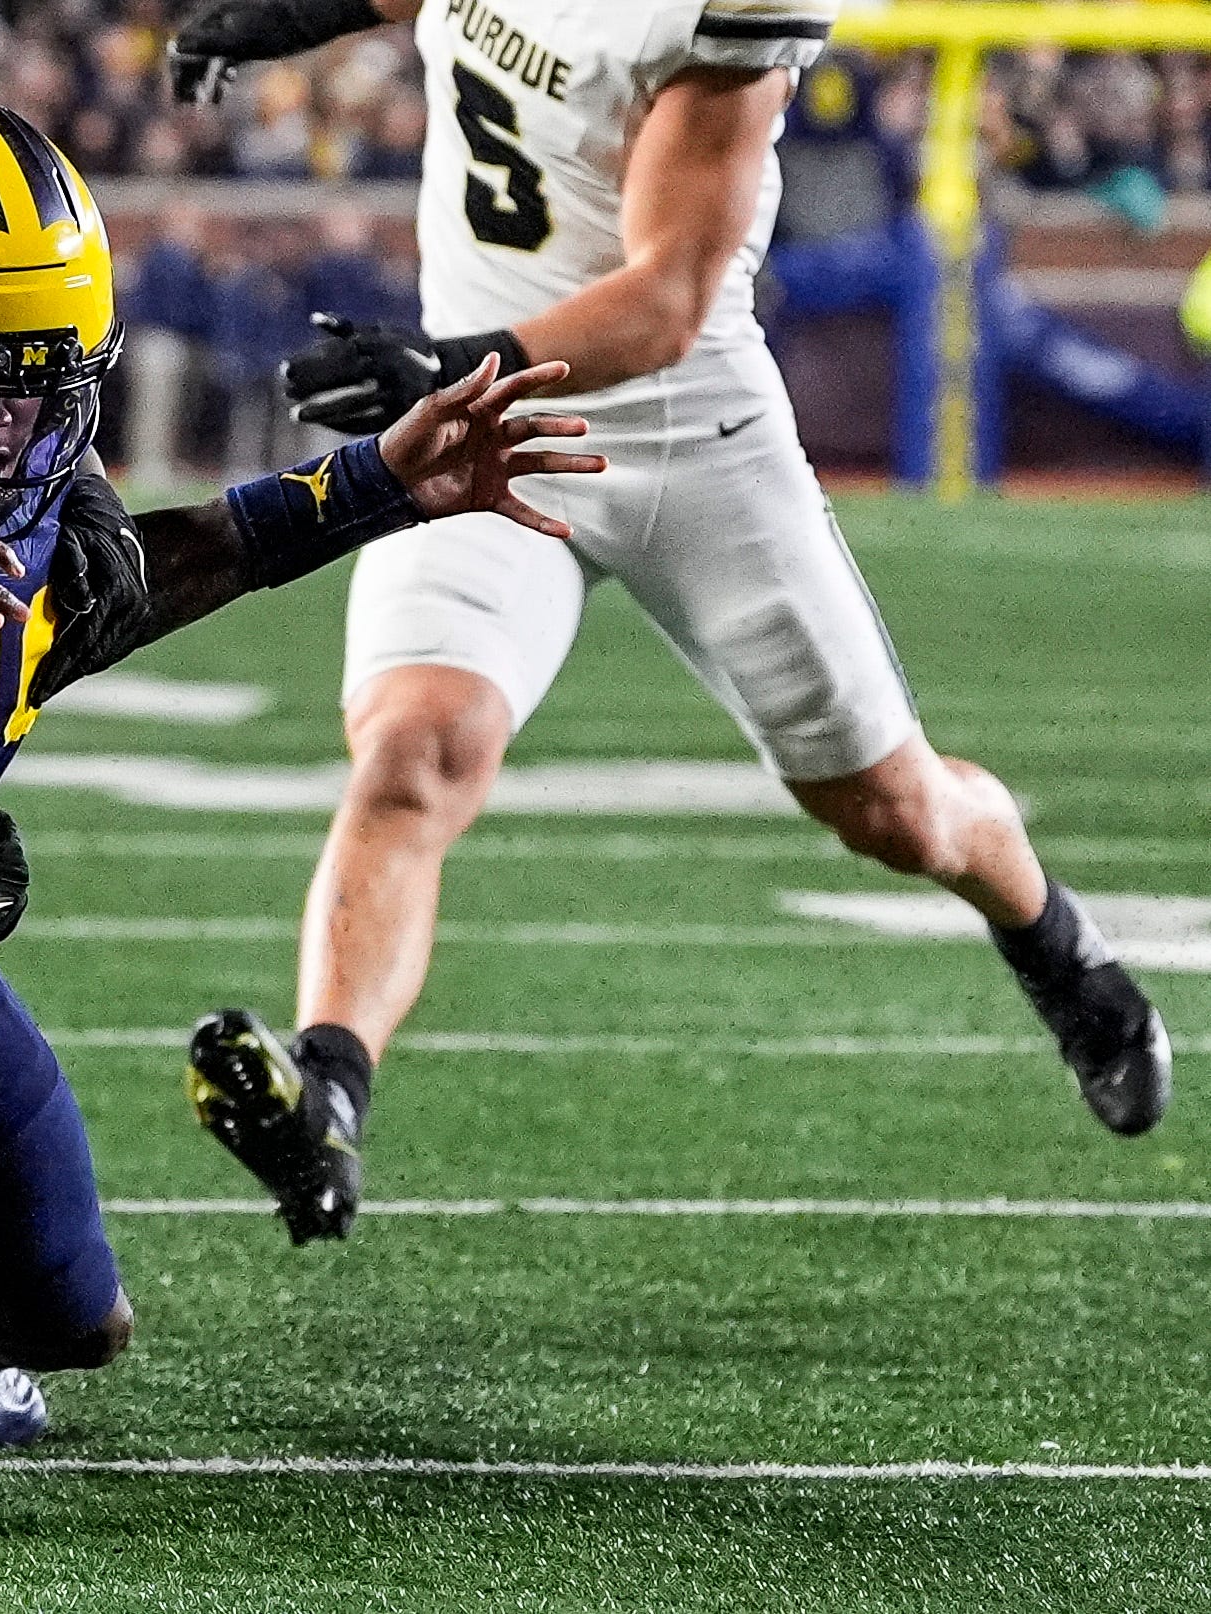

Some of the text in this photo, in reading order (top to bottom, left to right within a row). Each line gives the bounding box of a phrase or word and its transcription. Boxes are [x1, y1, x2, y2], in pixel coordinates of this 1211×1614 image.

[445, 0, 574, 102] PURDUE
[451, 56, 555, 255] 5
[20, 345, 50, 367] M
